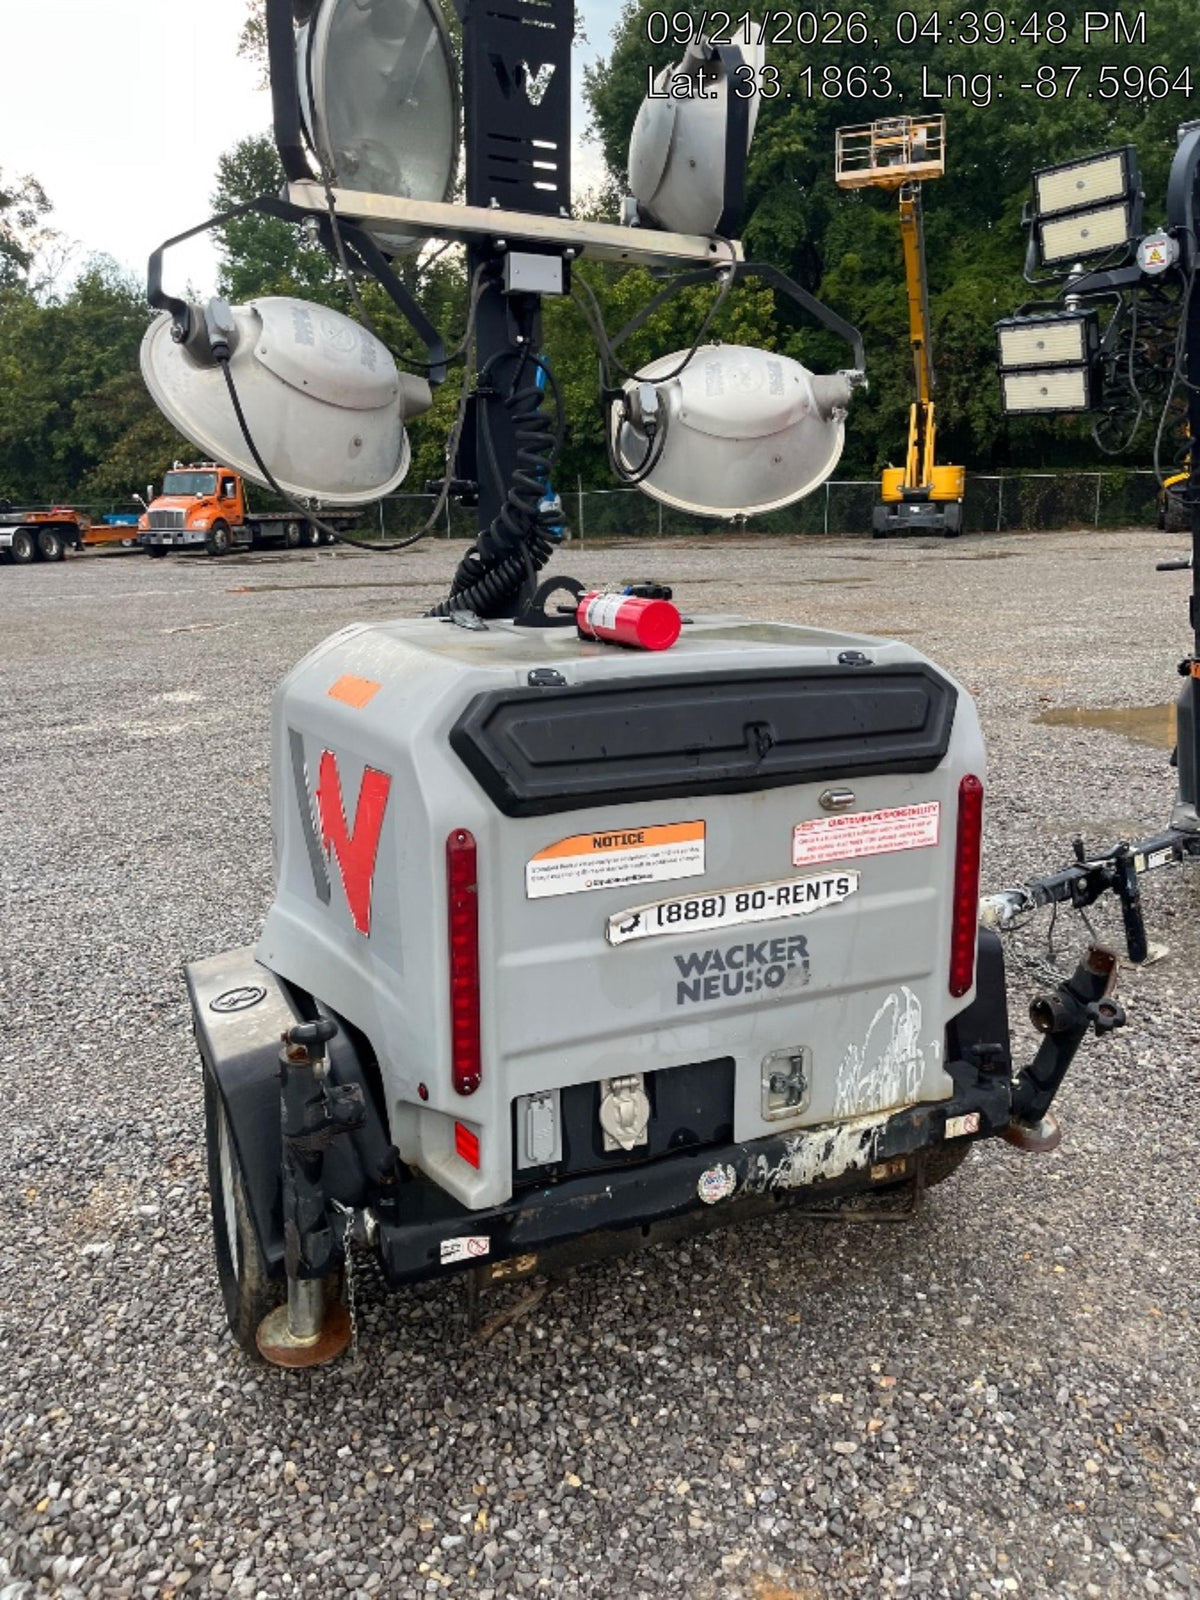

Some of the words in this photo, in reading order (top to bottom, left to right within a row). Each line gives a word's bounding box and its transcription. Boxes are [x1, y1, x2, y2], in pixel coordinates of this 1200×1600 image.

[593, 831, 645, 848] NOTICE
[657, 895, 726, 926] (888)
[735, 877, 850, 912] 80-RENTS
[673, 934, 810, 978] WACKER
